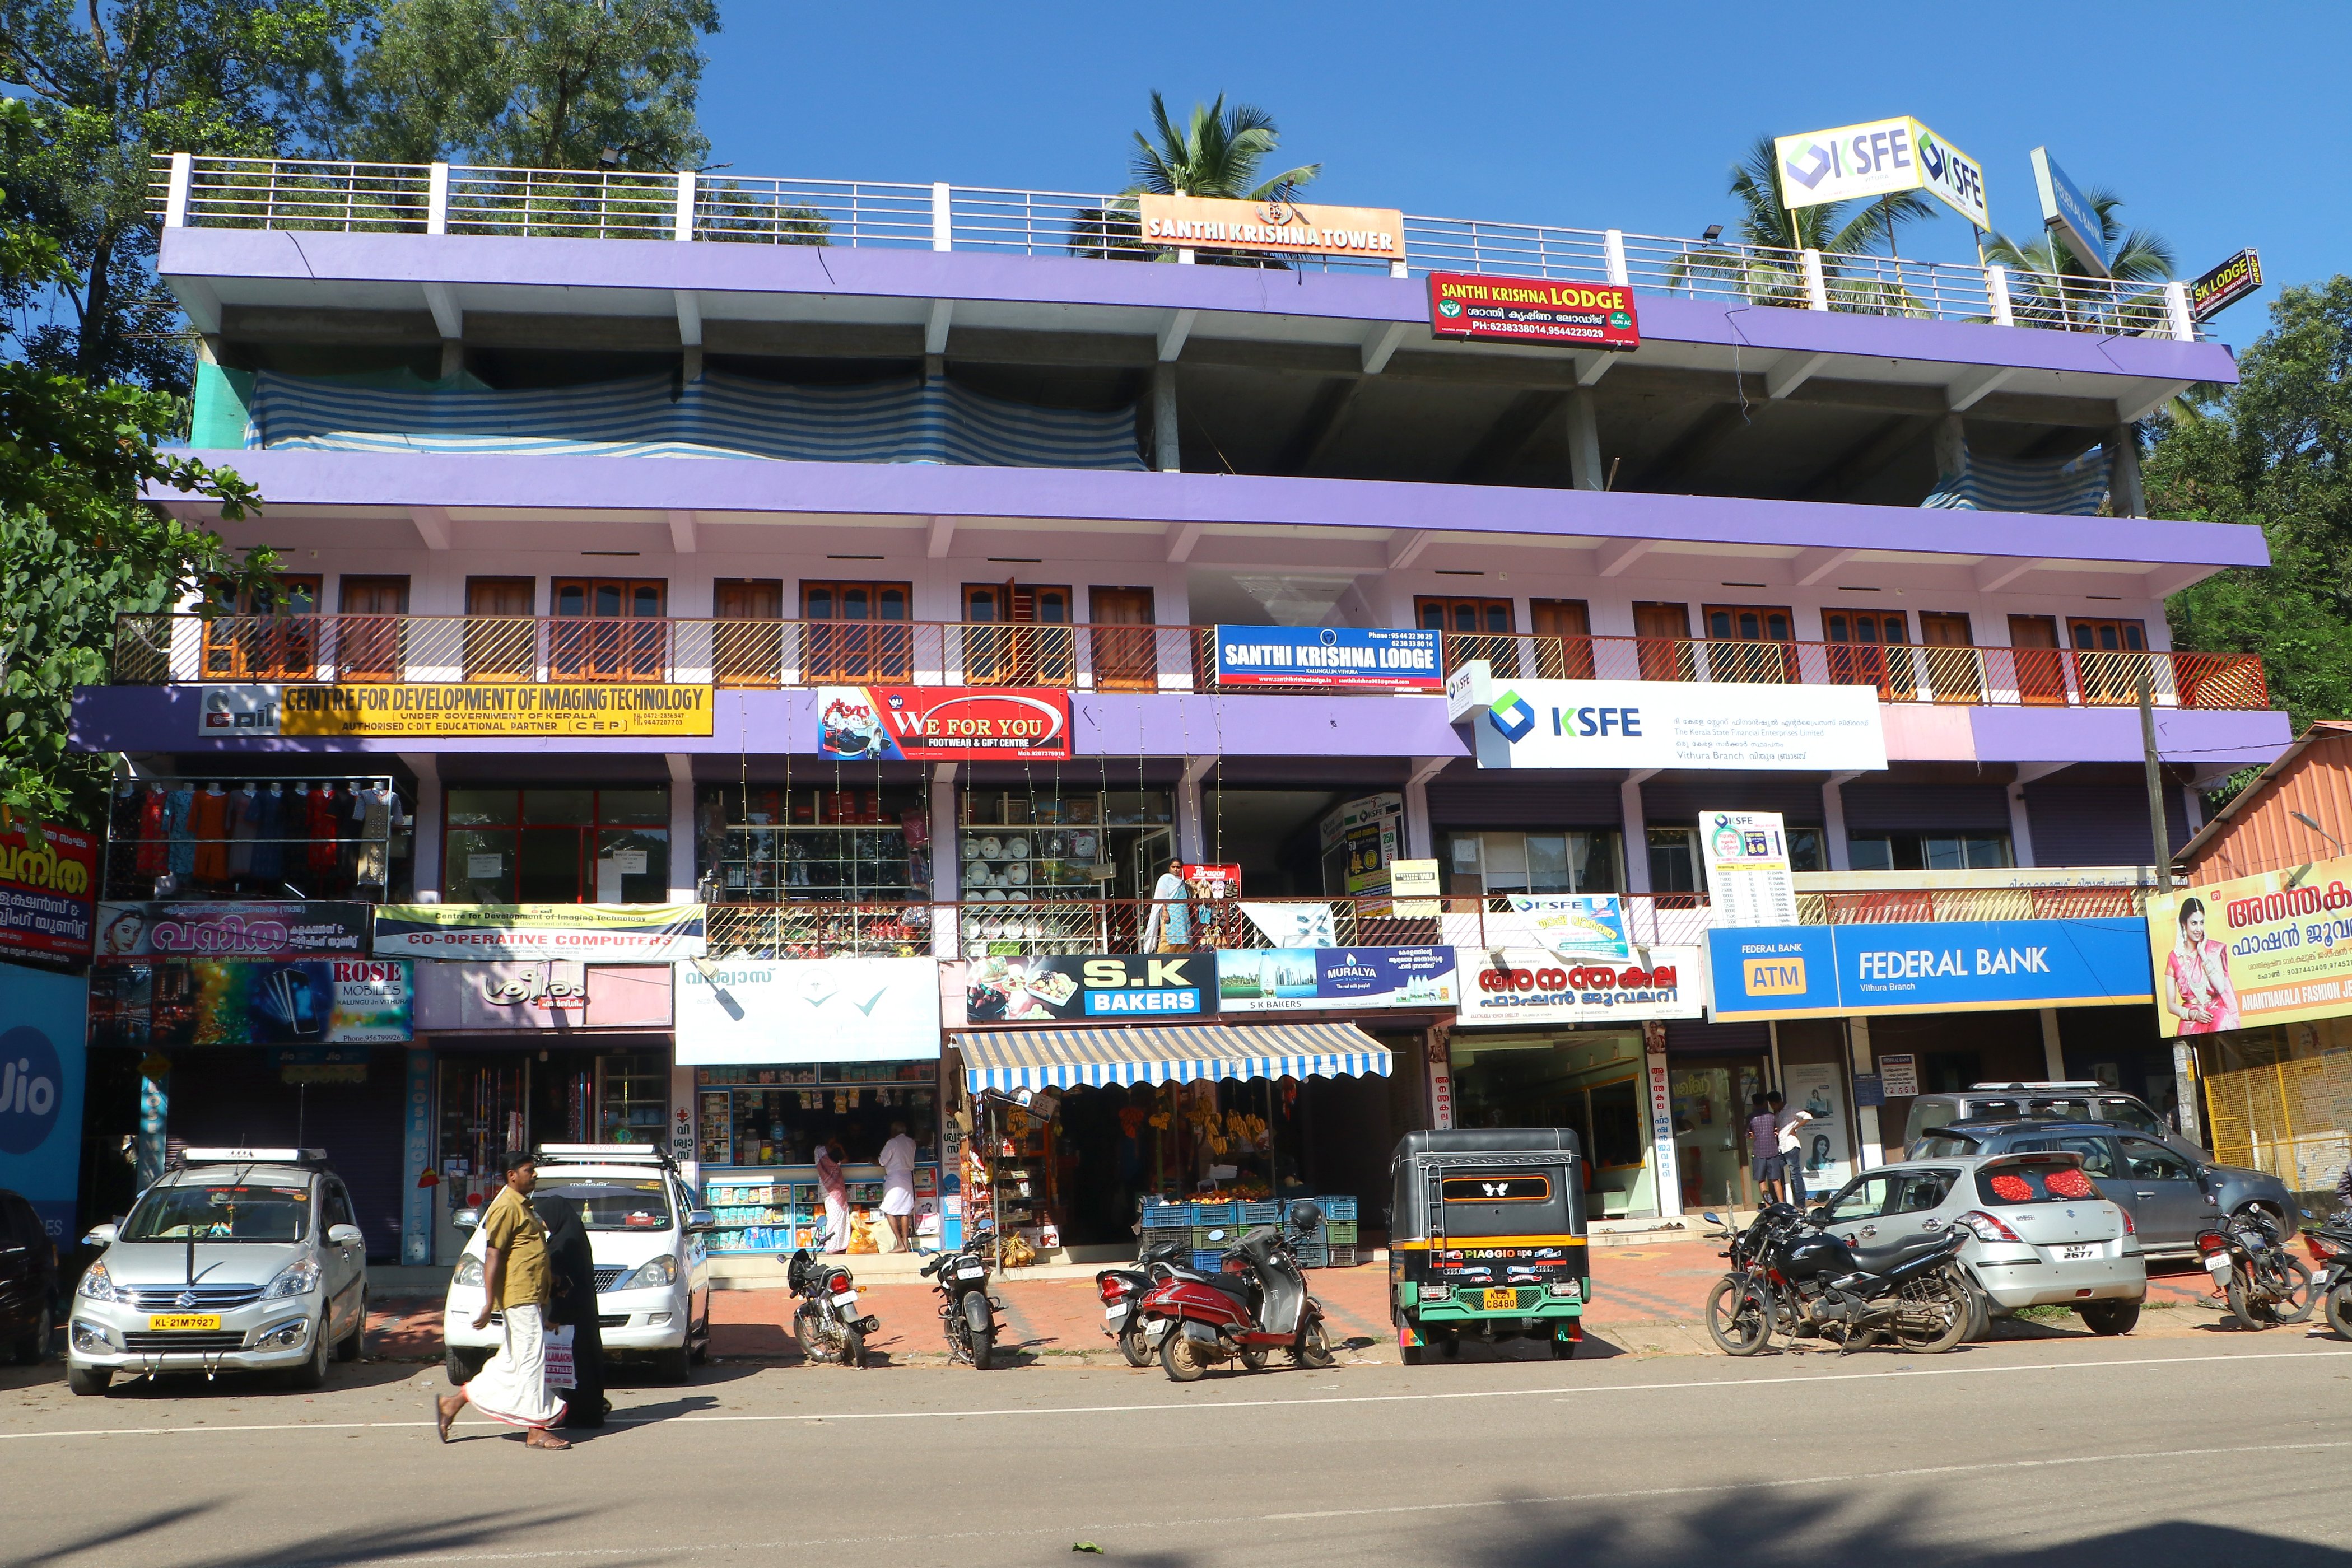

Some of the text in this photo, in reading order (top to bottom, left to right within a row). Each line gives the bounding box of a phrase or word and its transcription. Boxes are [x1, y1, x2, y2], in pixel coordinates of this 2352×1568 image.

[1831, 129, 1911, 178] KSFE
[1940, 148, 1983, 208] KSFE
[1149, 218, 1394, 250] SANTHI KRISHNA TOWER
[2195, 283, 2210, 301] SK
[2210, 258, 2248, 292] LODGE
[2251, 256, 2260, 283] LODGE
[1441, 283, 1625, 310] SANTHI KRISHNA LODGE
[1467, 307, 1505, 319] ശാന്തി
[1555, 313, 1604, 325] ലോഡ്ജ്
[1472, 321, 1604, 338] PH:6238338014,9544223029
[1224, 644, 1435, 669] SANTHI KRISHNA LODGE
[286, 688, 704, 711] CENTRE FOR DEVELOPMENT OF IMAGING TECHNOLOGY
[342, 722, 404, 731] AUTHORISED
[436, 722, 505, 731] EDUCATIONAL
[889, 711, 1042, 736] WE FOR YOU
[1552, 707, 1642, 736] KSFE
[928, 738, 1030, 748] FOOTWEAR & GIFT CENTRE
[1677, 752, 1710, 760] Vithura
[1713, 752, 1744, 760] Branch
[1749, 753, 1775, 762] വിതുര
[1349, 841, 1356, 851] 50
[1382, 833, 1394, 844] 250
[1193, 866, 1226, 878] Paragon
[484, 913, 543, 921] Development
[152, 915, 287, 951] വനിത
[408, 933, 673, 946] CO-OPERATIVE COMPUTERS
[2232, 923, 2300, 956] ഫാഷൻ
[1741, 943, 1803, 954] FEDERAL BANK
[333, 962, 402, 982] ROSE
[1083, 959, 1193, 987] S.K
[1859, 947, 2050, 979] FEDERAL BANK
[1327, 968, 1377, 979] MURALYA
[1478, 966, 1677, 992] അനന്തകല
[1753, 966, 1799, 987] ATM
[343, 985, 401, 996] MOBILES
[1860, 982, 1916, 992] Vithura Branch
[2242, 982, 2340, 1011] ANANTHAKALA FASHION
[1094, 992, 1195, 1011] BAKERS
[1480, 991, 1575, 1007] ഫാഷൻ
[674, 1123, 694, 1160] വിശ്വാസ്
[1465, 1250, 1515, 1258] PIAGGIO
[1517, 1250, 1532, 1258] ape
[155, 1319, 214, 1327] KL-21M-7927
